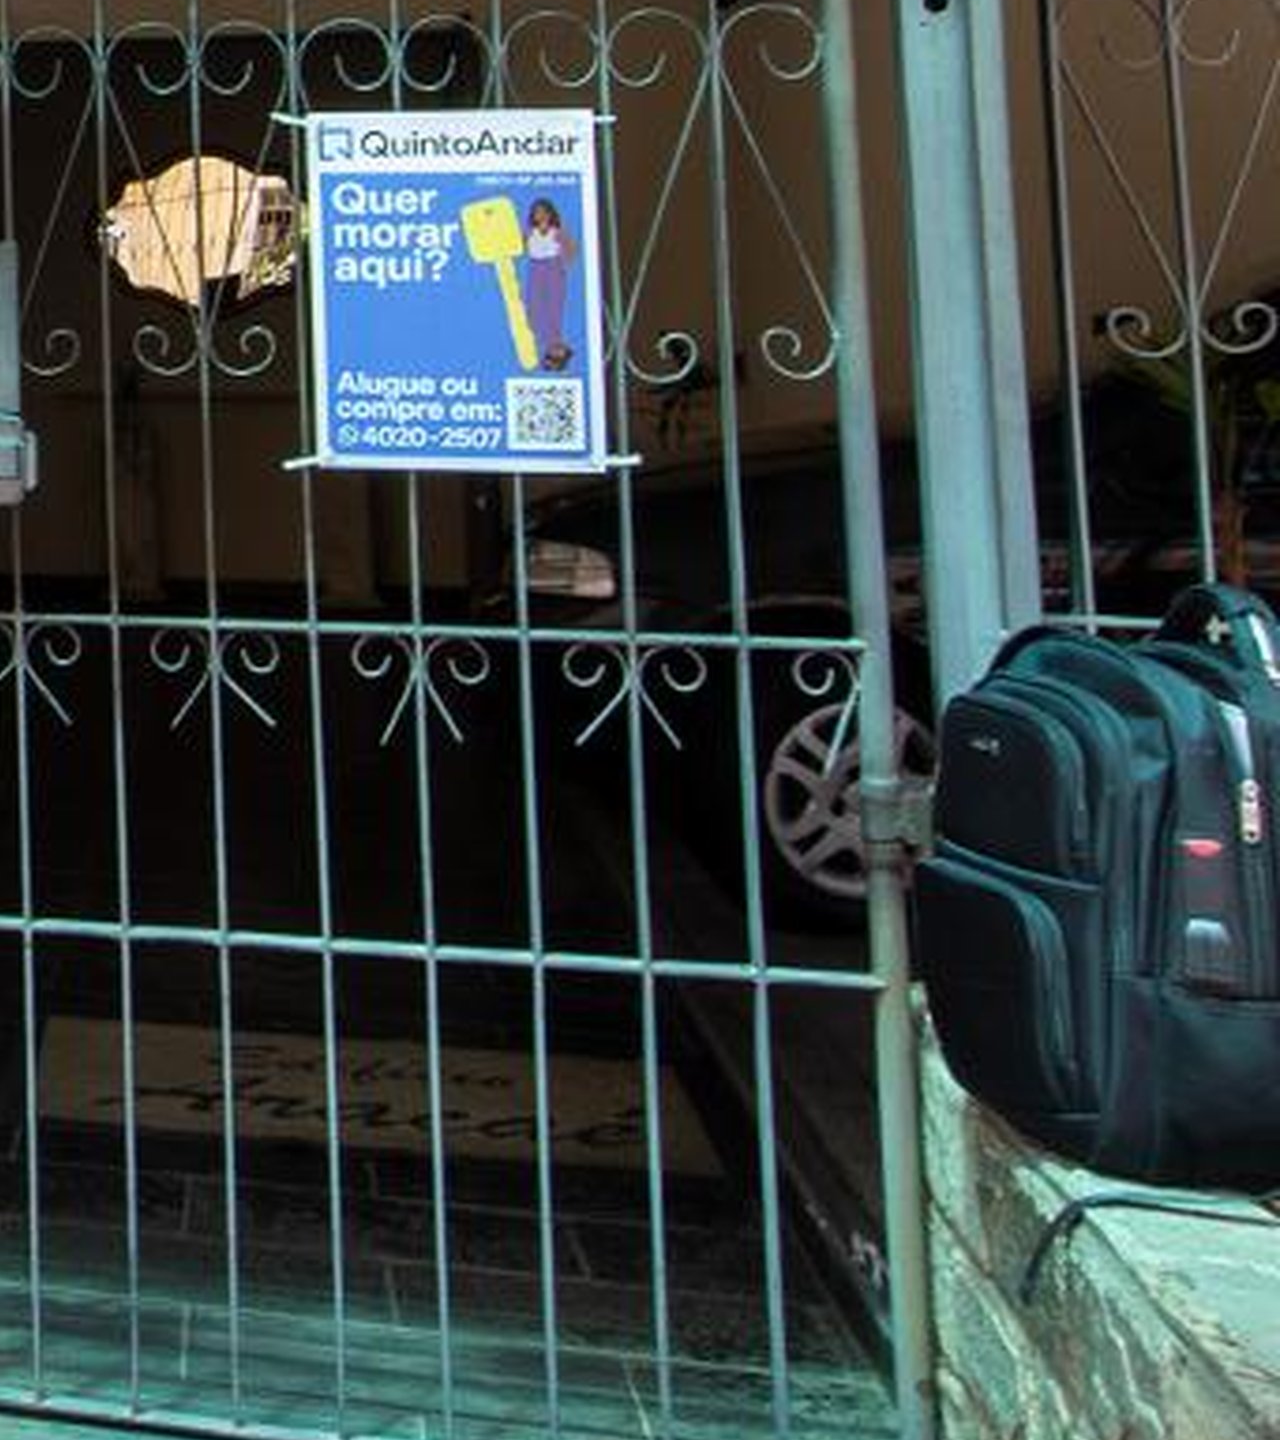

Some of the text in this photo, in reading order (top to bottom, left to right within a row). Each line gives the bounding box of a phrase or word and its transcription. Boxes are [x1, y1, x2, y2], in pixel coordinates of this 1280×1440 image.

[360, 130, 579, 158] QuintoAndar
[331, 181, 438, 215] Quer
[333, 222, 460, 248] morar
[333, 249, 450, 290] aqui?
[337, 370, 478, 399] Alugue ou
[336, 400, 503, 424] compre em:
[362, 425, 502, 448] 4020-2507
